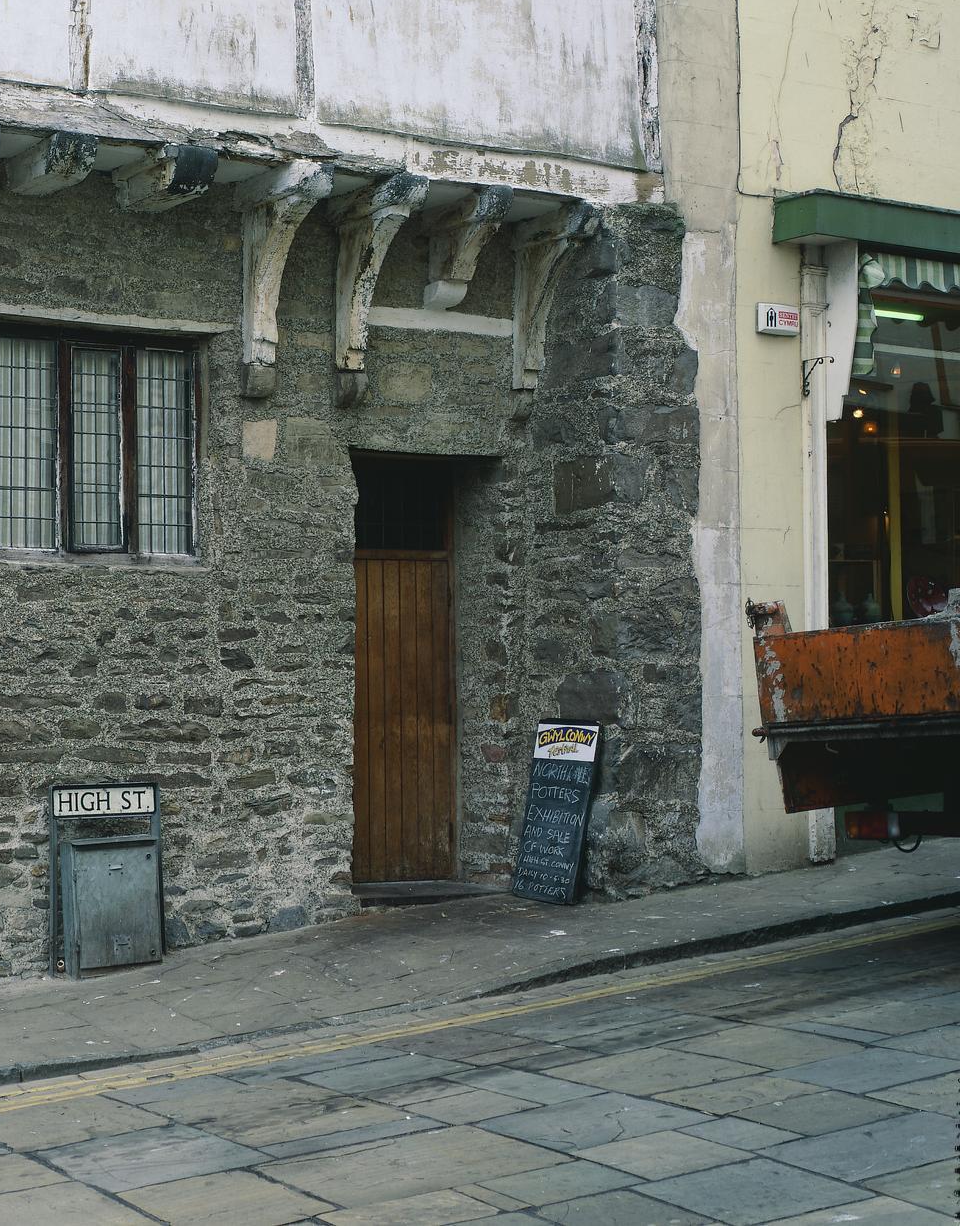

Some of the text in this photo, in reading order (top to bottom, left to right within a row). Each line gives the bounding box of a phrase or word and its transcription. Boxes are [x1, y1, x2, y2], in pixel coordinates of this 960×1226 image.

[58, 790, 149, 812] HIGH ST.
[531, 782, 581, 803] POTTERS
[527, 804, 585, 826] EXHIBITION
[524, 824, 570, 843] AND SALE
[524, 840, 565, 857] OF WORK
[523, 855, 539, 864] HIGH
[518, 867, 538, 879] DAILY
[514, 879, 566, 899] 16 POTTERS
